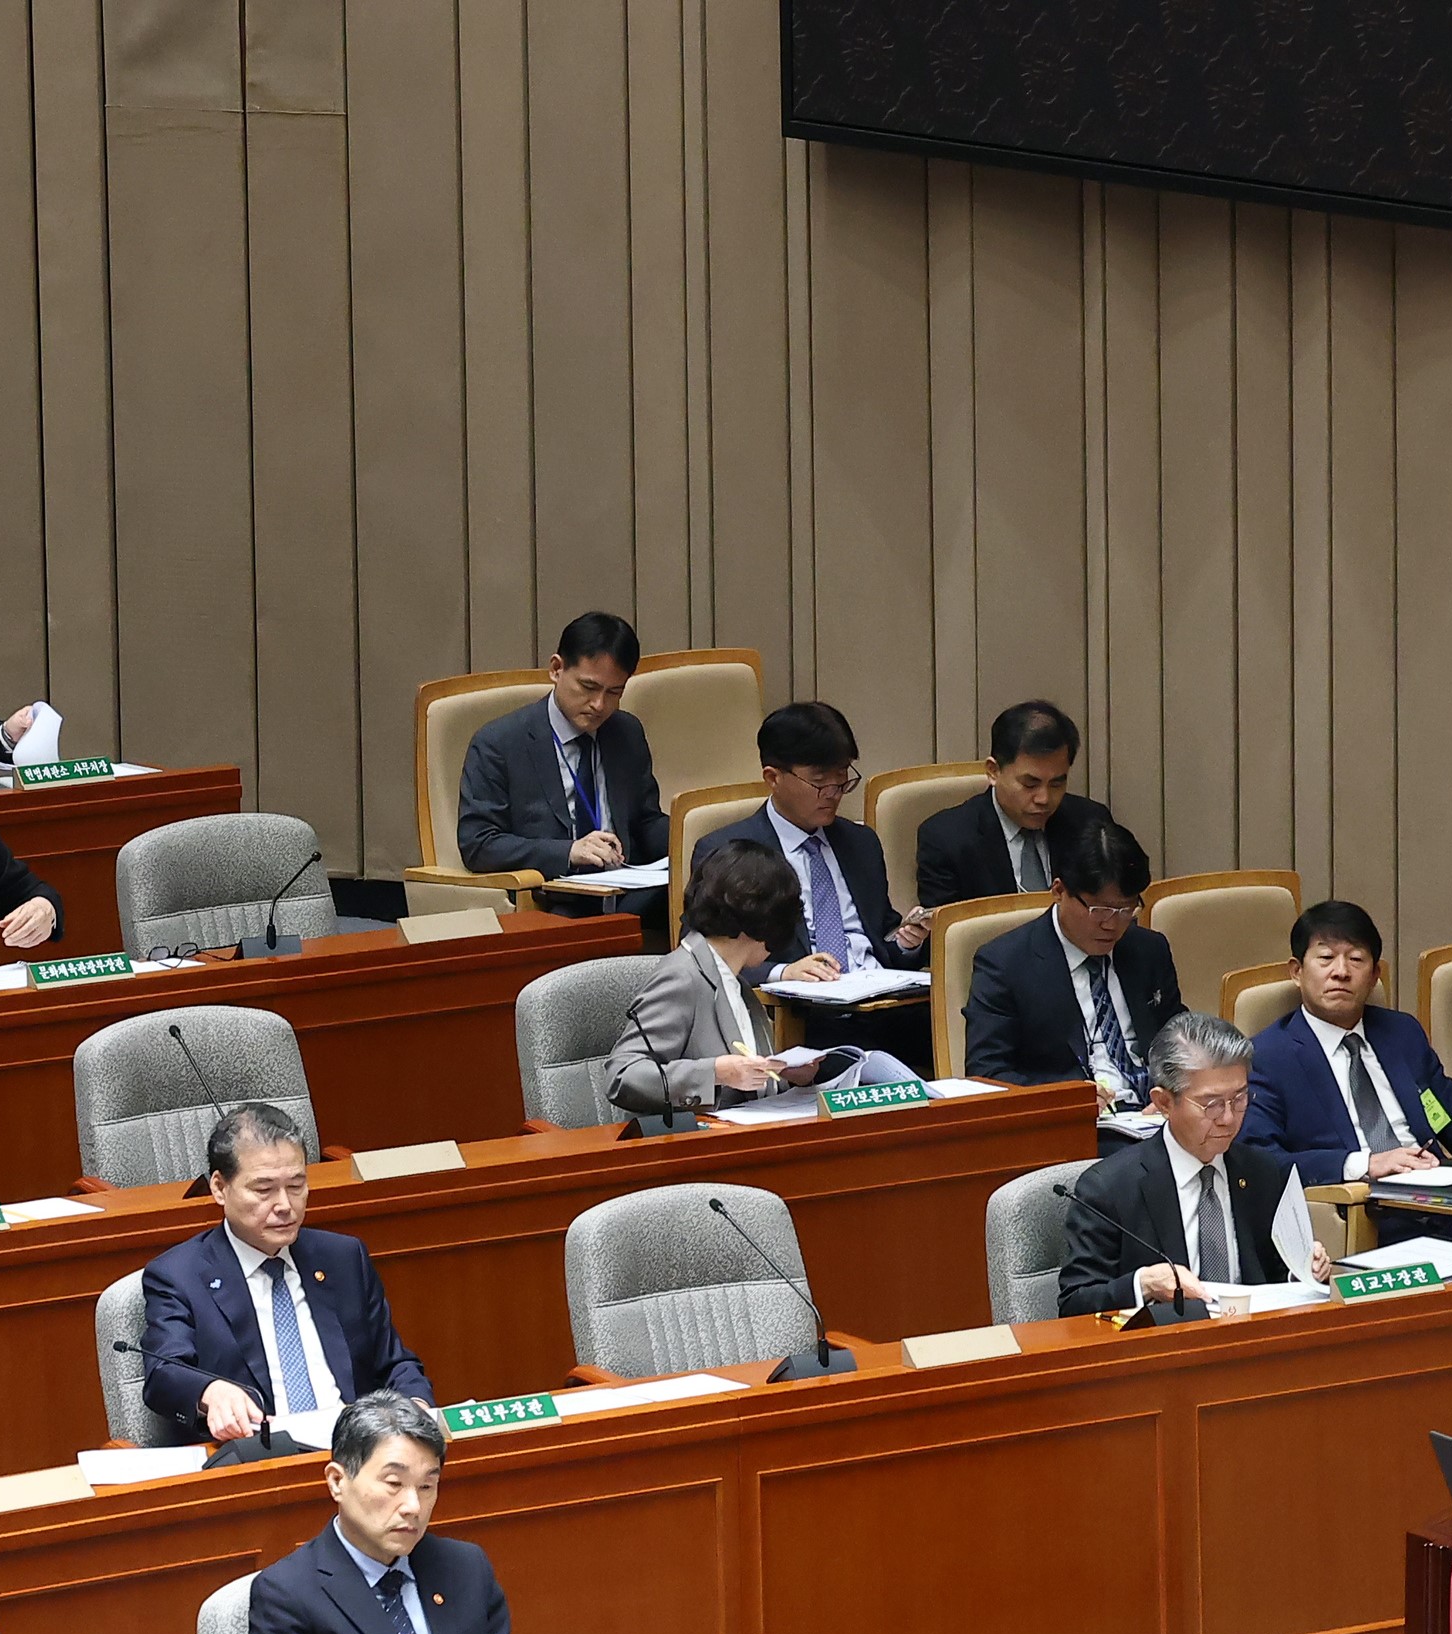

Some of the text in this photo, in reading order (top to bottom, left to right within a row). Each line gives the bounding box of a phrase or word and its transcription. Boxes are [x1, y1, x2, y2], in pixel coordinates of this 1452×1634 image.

[24, 762, 107, 781] 헌법재판소 사무처장
[38, 957, 126, 980] 문화체육관광부장관
[831, 1085, 921, 1107] 국가보훈부장관
[1350, 1267, 1428, 1293] 외교부장관
[459, 1399, 544, 1425] 통일부장관
